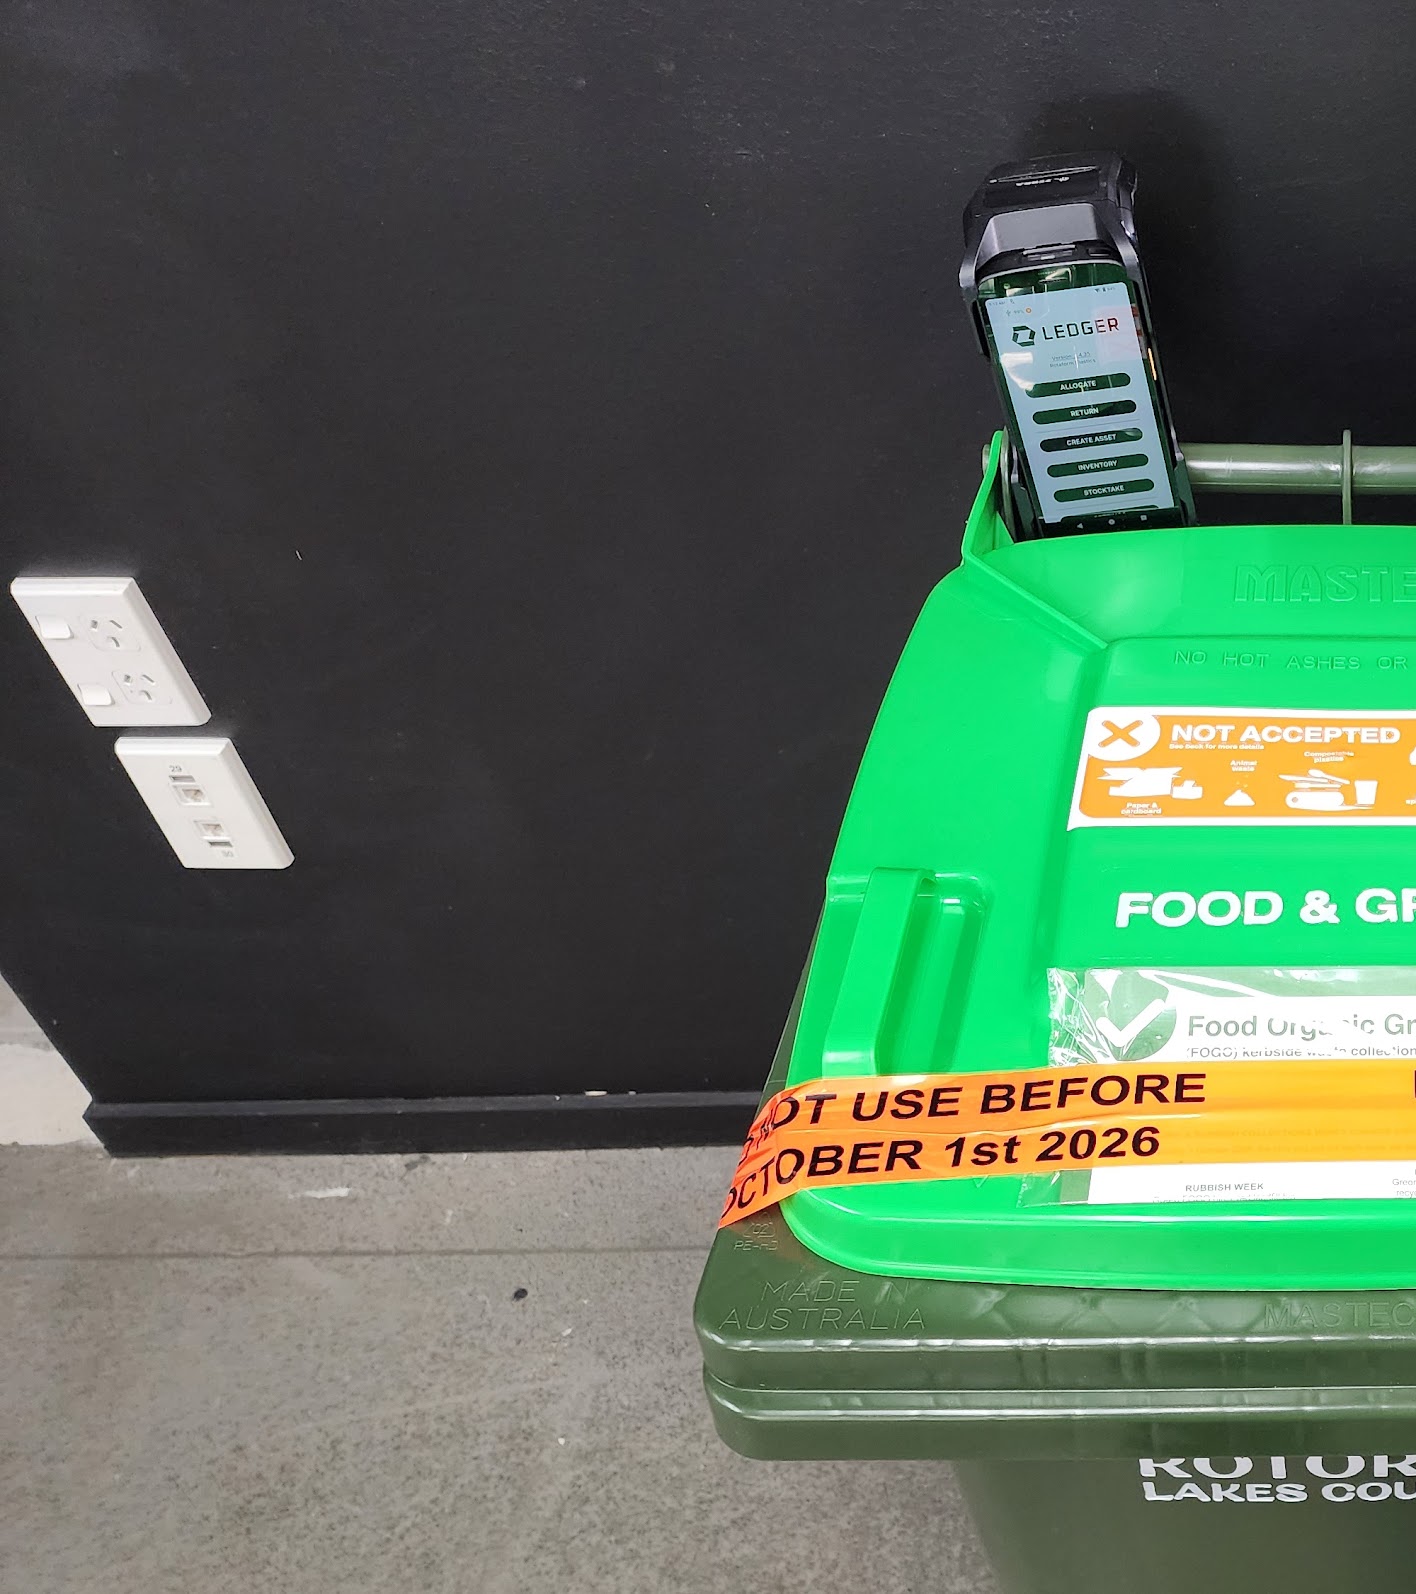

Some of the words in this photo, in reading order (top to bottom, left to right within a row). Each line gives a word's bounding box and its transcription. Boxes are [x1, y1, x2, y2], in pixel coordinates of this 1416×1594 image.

[1042, 317, 1119, 340] LEDGER
[1060, 380, 1097, 391] ALLOCATE
[1070, 407, 1099, 418] RETURN
[1066, 436, 1094, 447] CREATE
[1094, 433, 1117, 444] ASSET
[1077, 460, 1118, 472] INVENTORY
[1083, 484, 1125, 497] STOCKTAKE
[1174, 650, 1207, 666] NO
[1222, 651, 1270, 669] HOT
[1286, 655, 1362, 671] ASHES
[1377, 656, 1409, 671] OR
[1171, 724, 1235, 742] NOT
[1239, 725, 1400, 744] ACCEPTED
[1115, 890, 1284, 928] FOOD
[1300, 889, 1340, 925] &
[1188, 1015, 1258, 1037] Food
[1268, 1014, 1375, 1042] Orgic
[851, 1087, 960, 1121] USE
[981, 1073, 1206, 1113] BEFORE
[943, 1136, 1019, 1168] 1st
[1035, 1126, 1161, 1161] 2026
[1185, 1184, 1231, 1192] RUBBISH
[1234, 1183, 1264, 1191] WEEK
[761, 1280, 860, 1302] MADE
[718, 1307, 925, 1331] AUSTRALIA
[1264, 1302, 1416, 1328] MASTEC
[1142, 1481, 1308, 1502] LAKES
